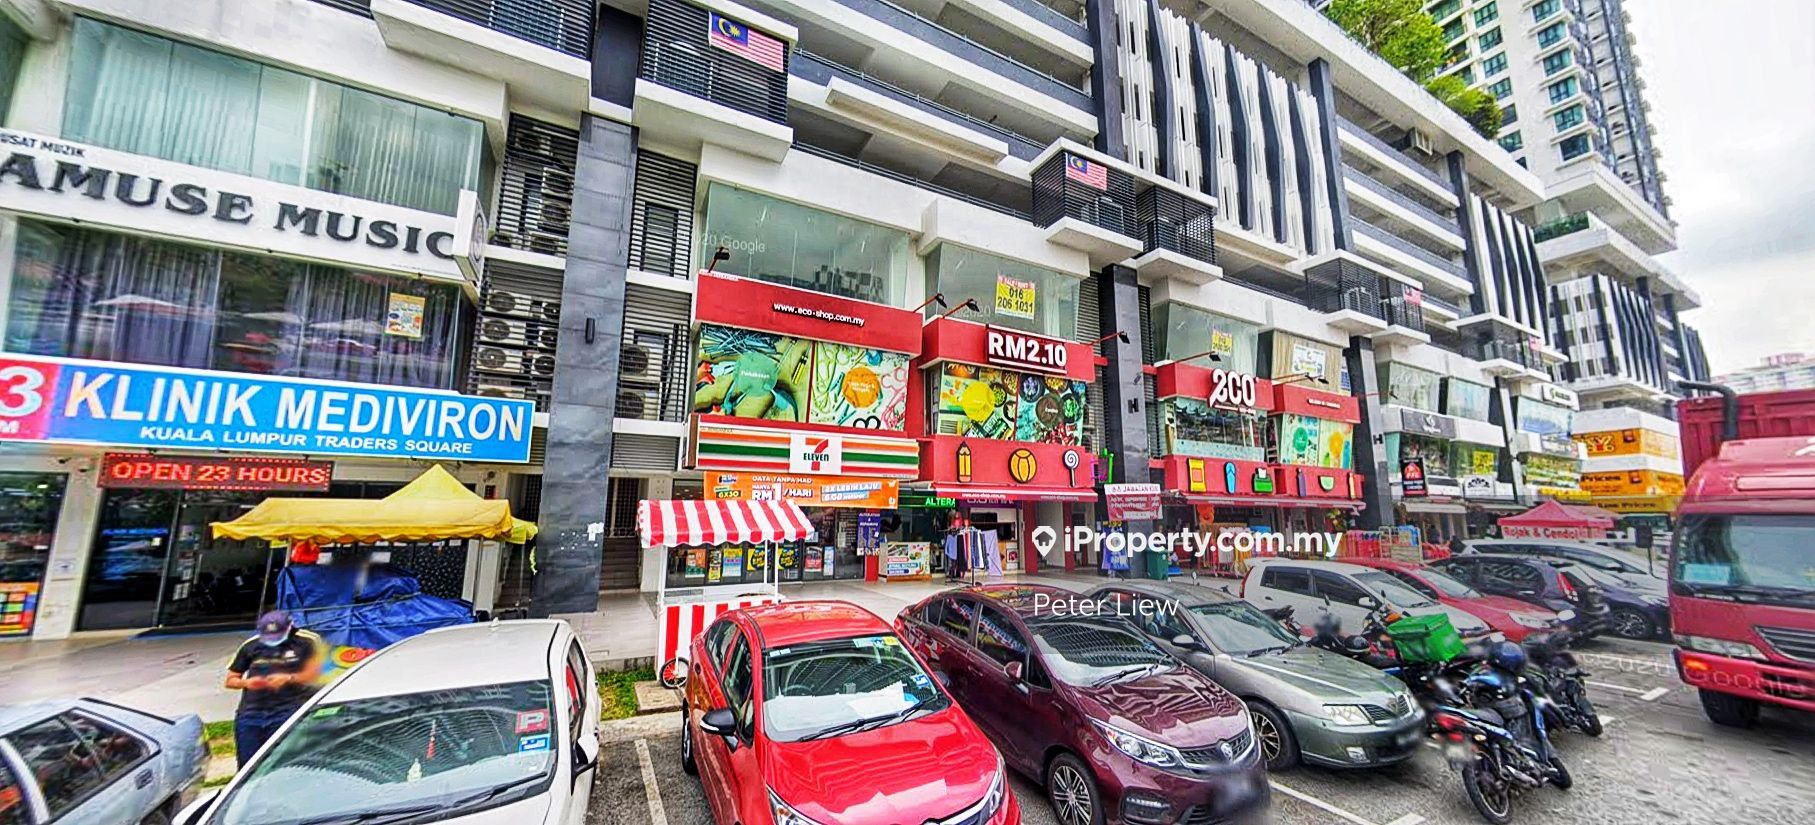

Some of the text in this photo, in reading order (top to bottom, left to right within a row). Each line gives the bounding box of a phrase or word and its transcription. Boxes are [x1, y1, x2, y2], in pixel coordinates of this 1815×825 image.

[41, 141, 85, 158] MUZIK
[0, 151, 455, 260] AMUSE MUSIC
[997, 296, 1034, 313] 206 1031
[1009, 288, 1024, 300] 016
[987, 331, 1068, 368] RM2.10
[0, 365, 45, 418] 3
[64, 370, 525, 443] KLINIK MEDIVIRON
[140, 426, 473, 454] KUALA LUMPUR TRADERS SQUARE
[804, 436, 829, 471] 7
[112, 461, 327, 484] OPEN 23 HOURS
[751, 489, 774, 501] RM
[520, 711, 545, 729] P
